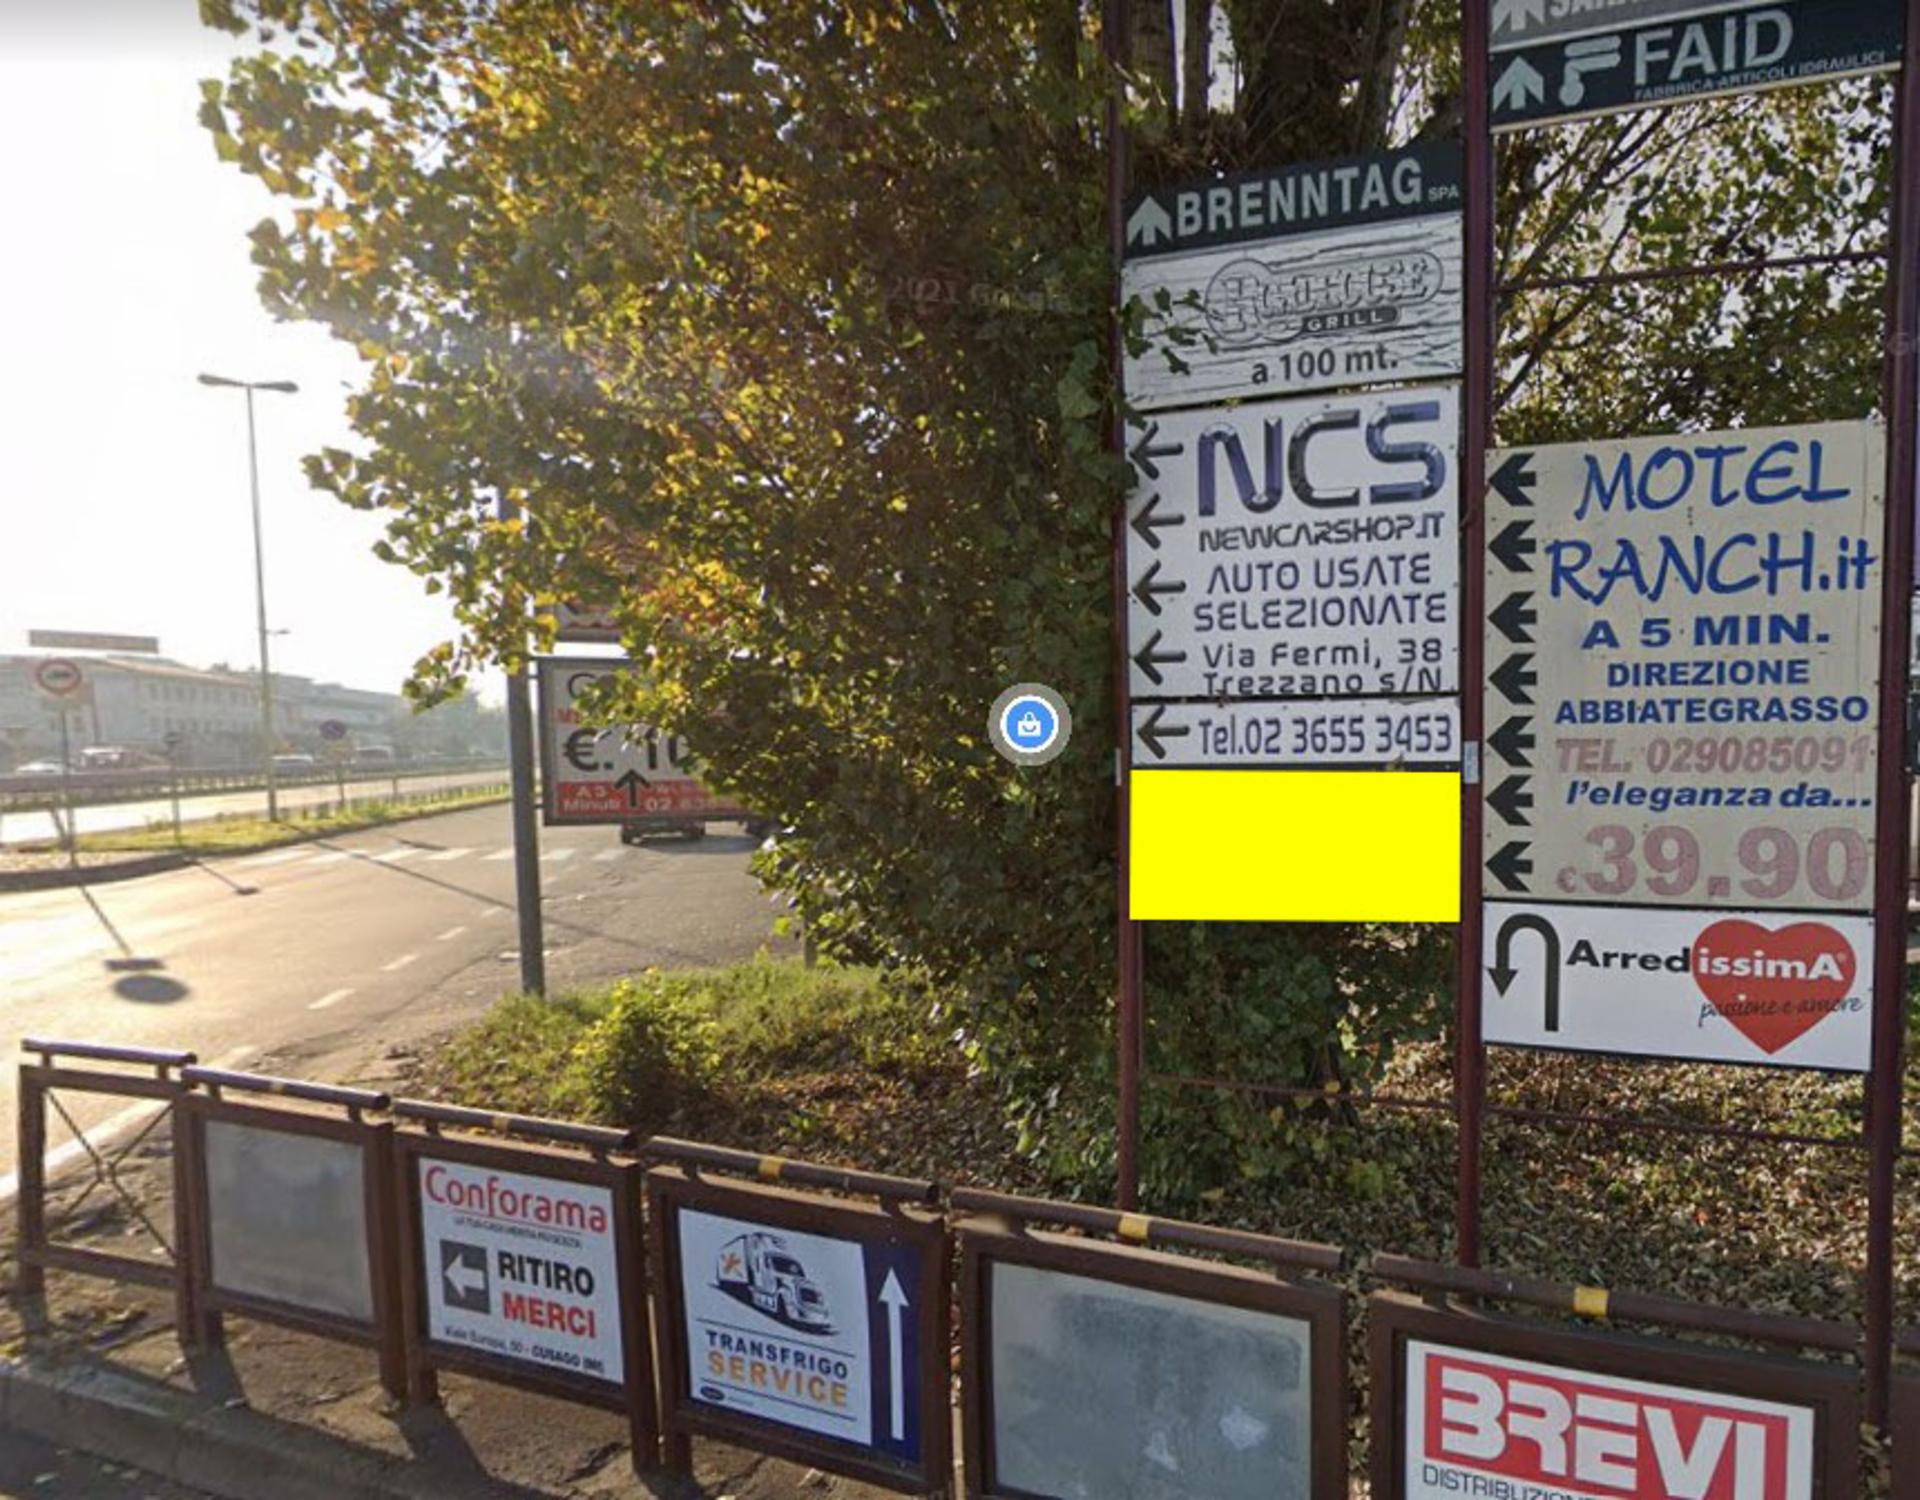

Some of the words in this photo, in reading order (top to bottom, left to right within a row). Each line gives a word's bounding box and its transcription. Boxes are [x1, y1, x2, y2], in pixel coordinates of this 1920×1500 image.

[1635, 10, 1794, 84] FAID
[1177, 158, 1422, 237] BRENNTAG
[1427, 186, 1460, 202] SPA
[1306, 311, 1383, 332] GRILL
[1252, 364, 1268, 384] a
[1280, 348, 1336, 381] 100
[1345, 344, 1398, 373] mt.
[1198, 401, 1446, 517] NCS
[1574, 439, 1851, 521] MOTEL
[1199, 511, 1446, 552] NEWCARSHOP.IT
[1207, 562, 1300, 595] AUTO
[1313, 553, 1431, 589] USATE
[1545, 531, 1878, 606] RANCH.it
[1194, 591, 1447, 633] SELEZIONATE
[1581, 621, 1620, 650] A
[1640, 618, 1672, 647] 5
[1693, 613, 1830, 646] MIN.
[1203, 643, 1255, 668] Via
[1271, 638, 1382, 669] Fermi,
[1398, 638, 1442, 664] 38
[1607, 659, 1810, 687] DIREZIONE
[1203, 672, 1363, 697] Trezzano
[1379, 665, 1442, 693] s/N
[1554, 696, 1870, 725] ABBIATEGRASSO
[1199, 714, 1282, 755] Tel.02
[1291, 714, 1366, 755] 3655
[1376, 713, 1451, 754] 3453
[1555, 738, 1632, 774] TEL.
[1566, 781, 1773, 812] l'eleganza
[1779, 783, 1872, 807] da...
[425, 1165, 608, 1233] Conforama
[497, 1250, 595, 1298] RITIRO
[503, 1291, 597, 1339] MERCI
[705, 1330, 848, 1379] TRANSFRIGO
[707, 1351, 849, 1408] SERVICE
[1441, 1365, 1767, 1500] BREVI
